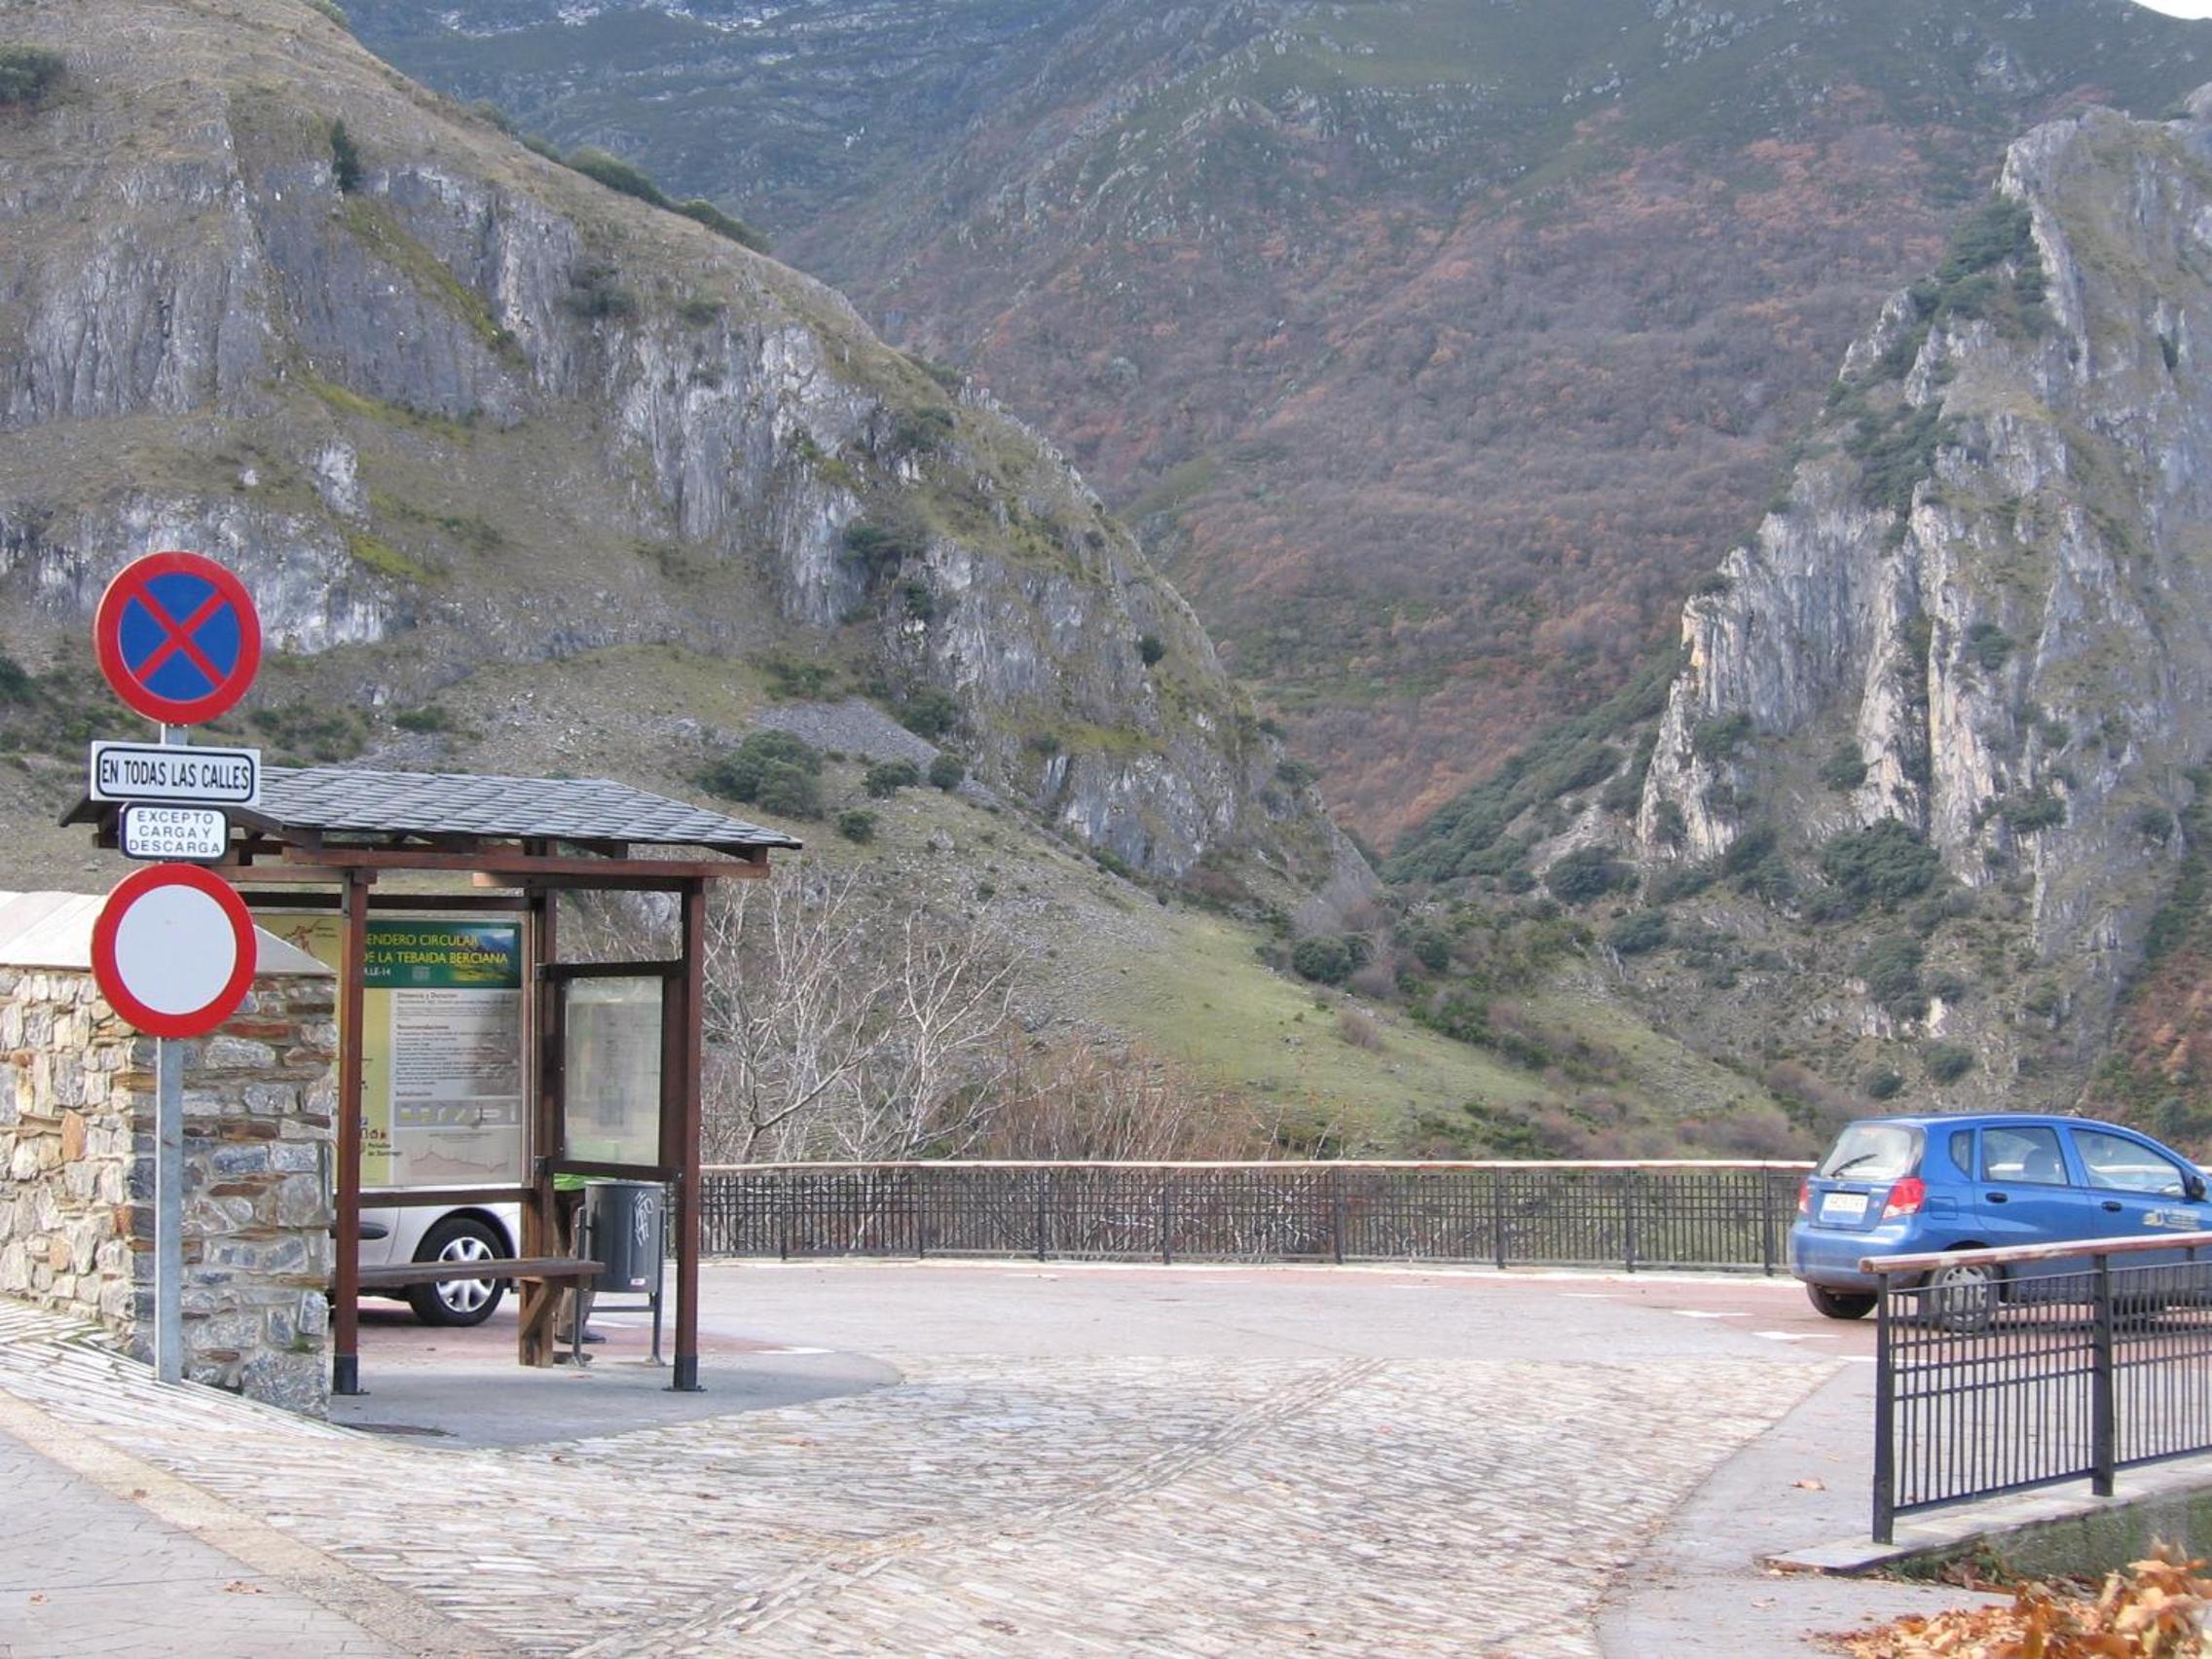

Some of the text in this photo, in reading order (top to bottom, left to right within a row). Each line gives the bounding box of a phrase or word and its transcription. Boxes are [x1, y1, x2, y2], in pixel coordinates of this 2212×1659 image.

[102, 759, 249, 790] EN TODAS LAS CALLES
[137, 810, 214, 825] EXCEPTO
[139, 826, 211, 838] CARGA Y
[129, 839, 220, 854] DESCARGA
[366, 934, 417, 946] ENDERO
